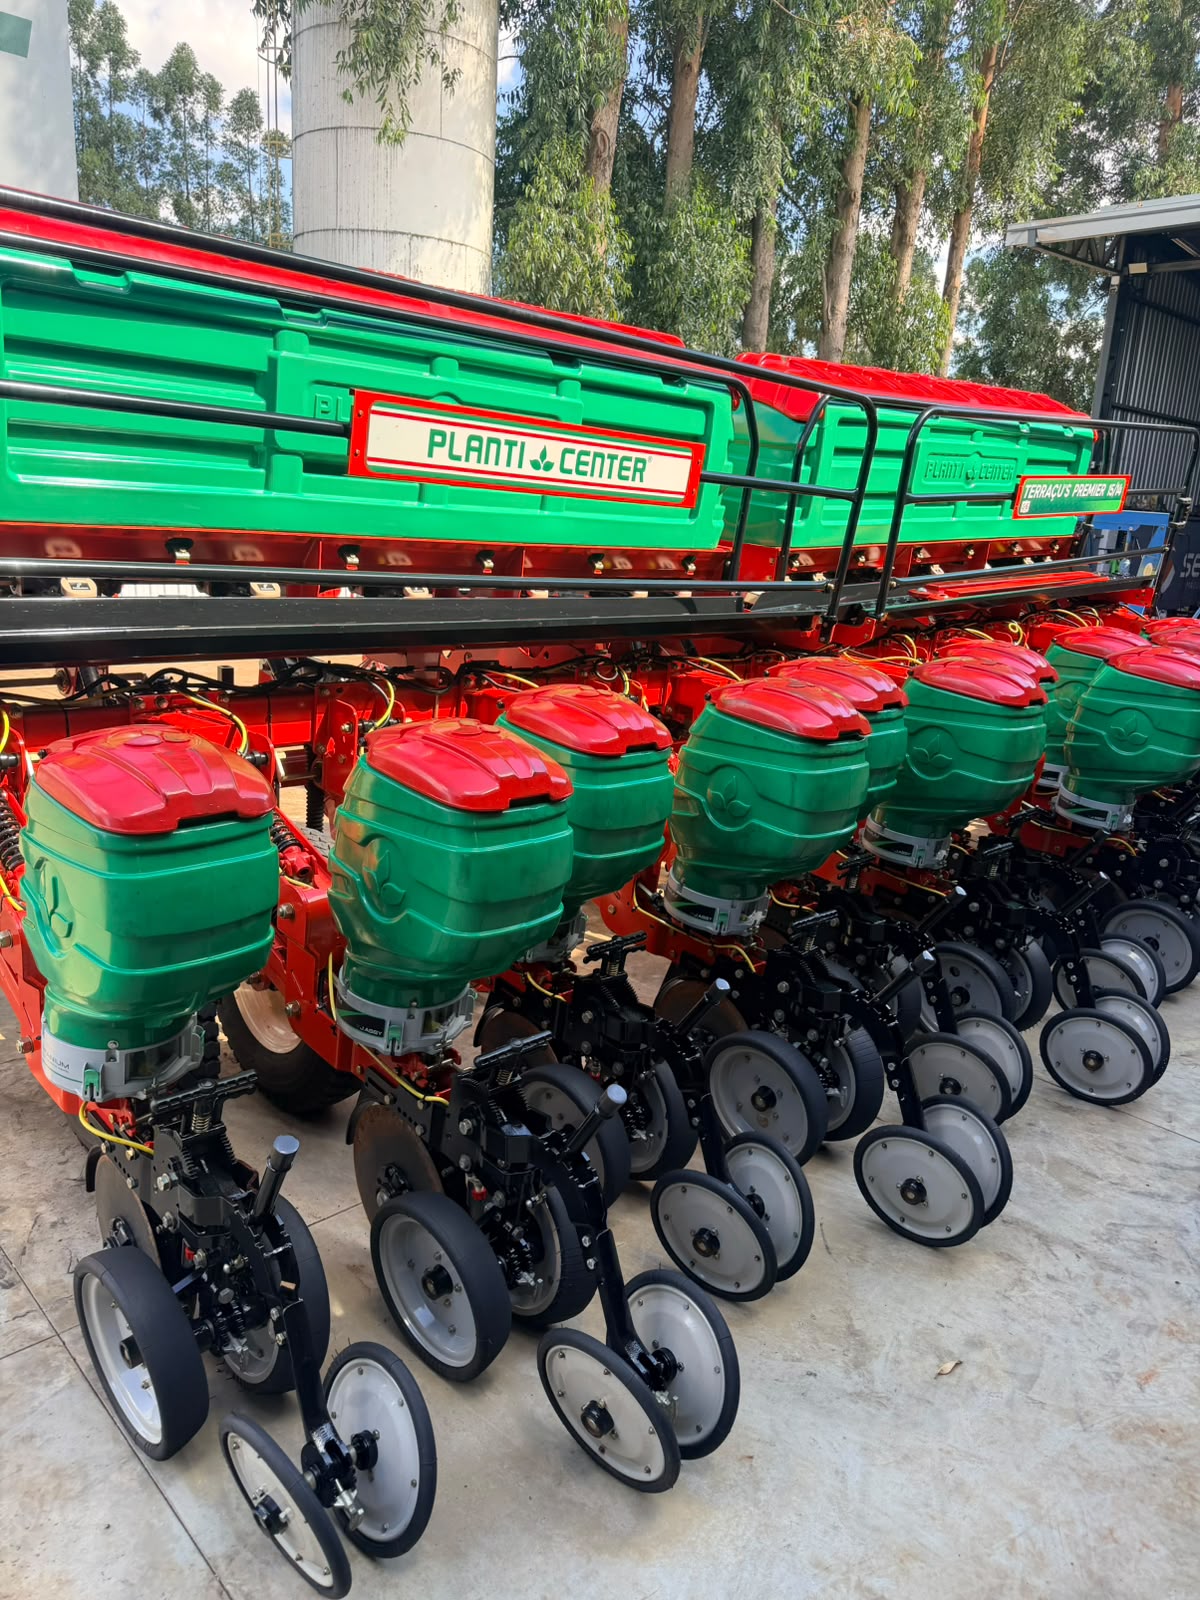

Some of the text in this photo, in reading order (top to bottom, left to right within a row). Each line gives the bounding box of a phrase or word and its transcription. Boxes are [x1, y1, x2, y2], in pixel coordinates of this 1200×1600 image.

[427, 428, 526, 469] PLANTI
[924, 460, 1016, 481] PLANTI CENTER
[1023, 483, 1072, 502] TERRAÇU'S
[1072, 483, 1107, 497] PREMIER
